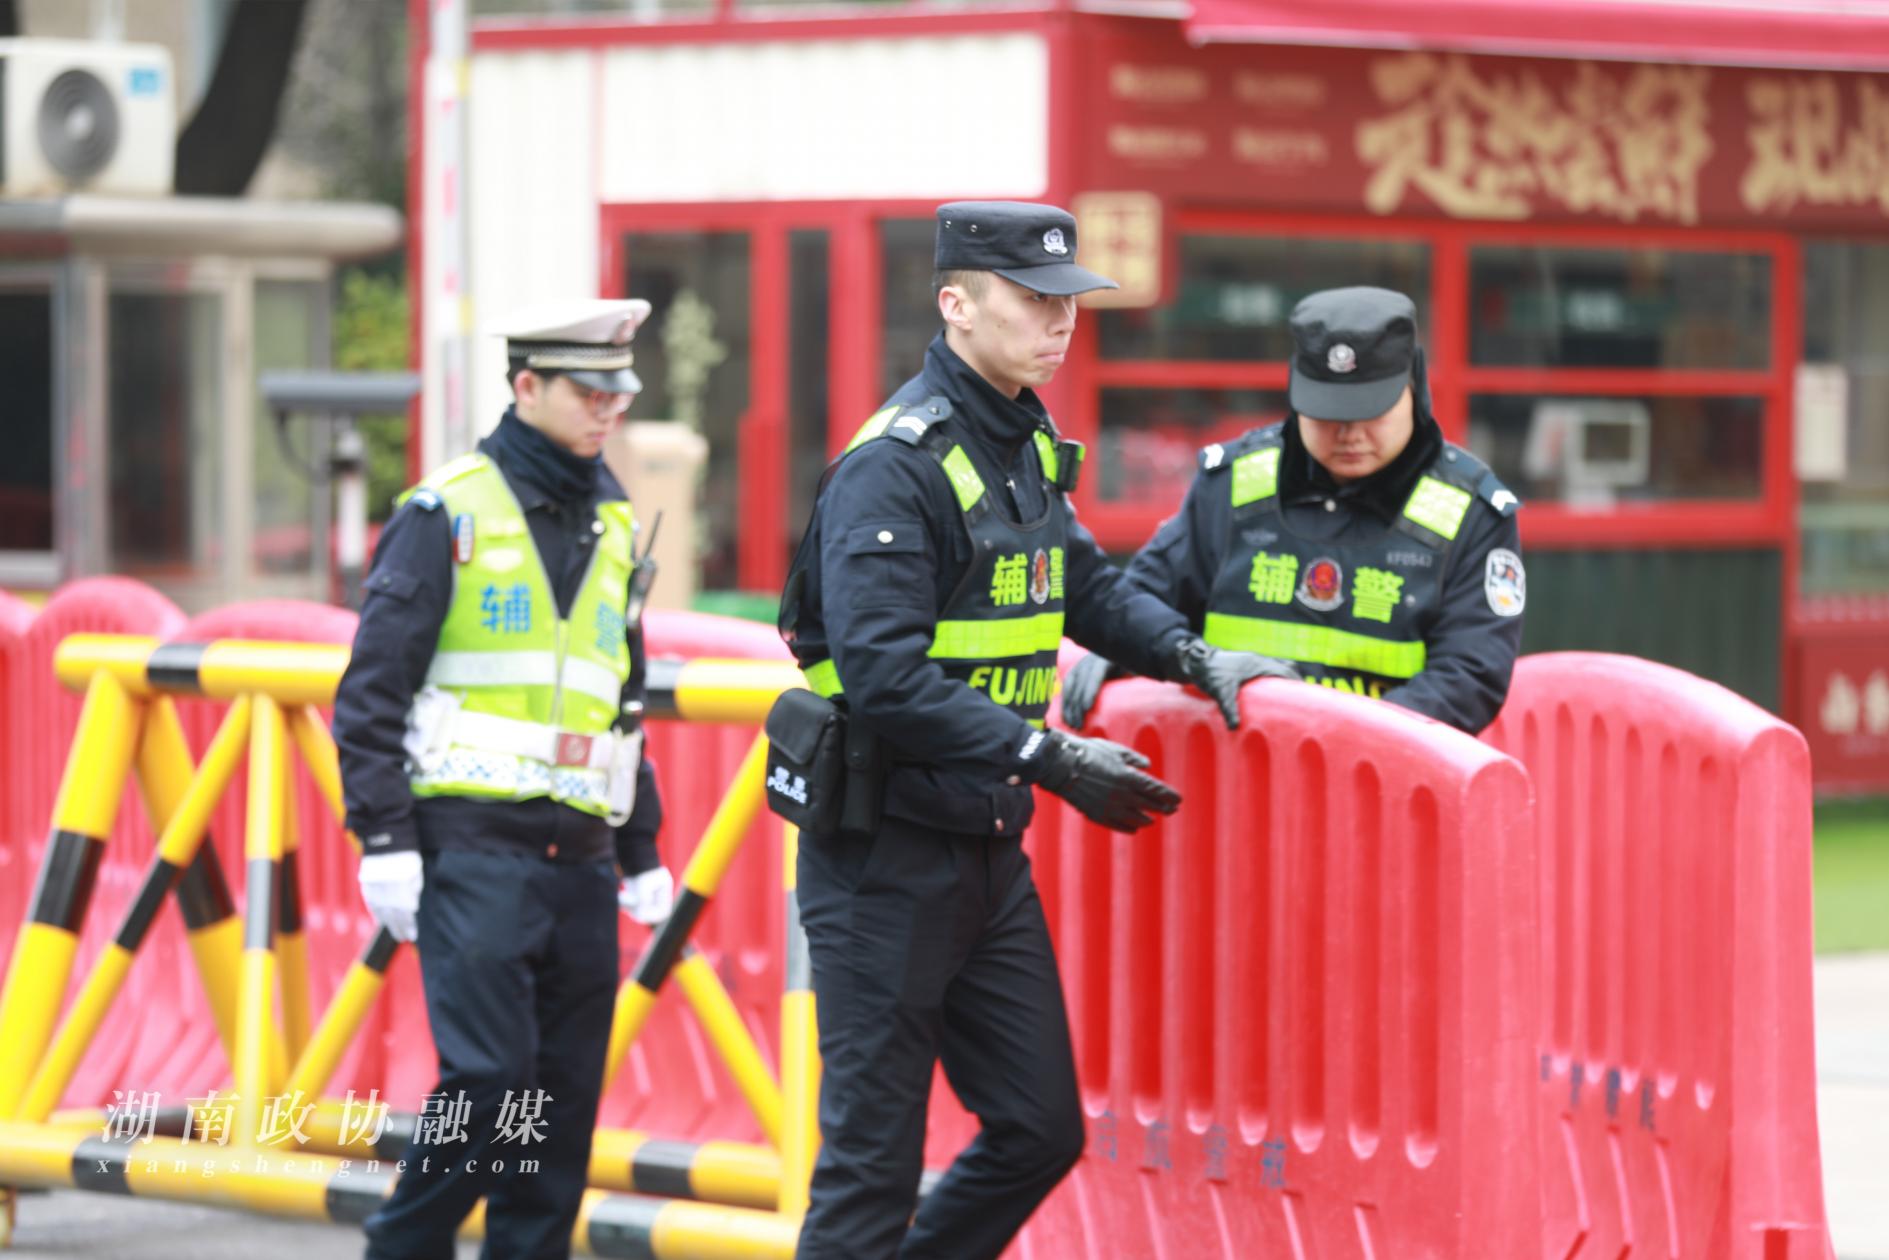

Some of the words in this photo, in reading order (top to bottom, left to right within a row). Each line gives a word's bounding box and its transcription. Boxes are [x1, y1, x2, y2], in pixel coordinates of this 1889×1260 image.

[990, 553, 1028, 606] 辅
[1249, 551, 1299, 604] 辅
[1352, 566, 1404, 623] 警
[767, 775, 808, 804] POLICE
